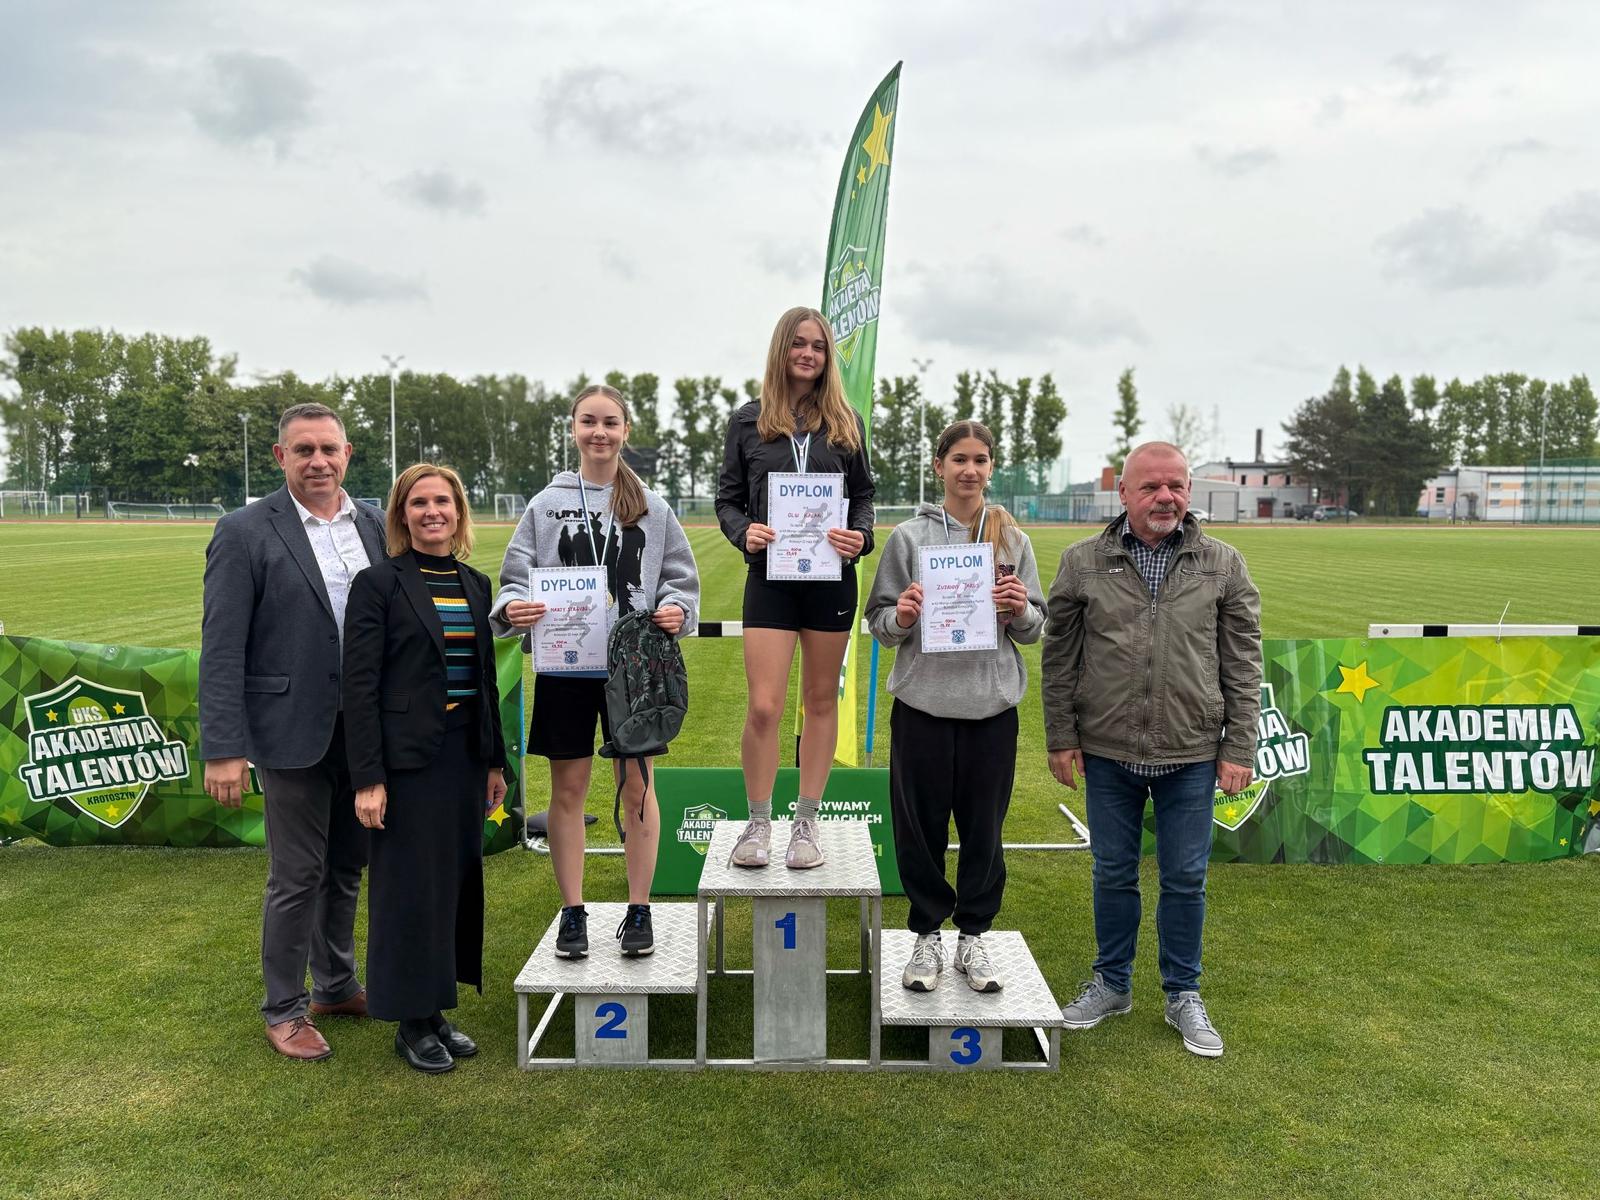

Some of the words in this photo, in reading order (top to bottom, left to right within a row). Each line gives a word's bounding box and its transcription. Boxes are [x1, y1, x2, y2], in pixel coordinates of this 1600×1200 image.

[780, 485, 833, 497] DYPLOM
[930, 555, 983, 570] DYPLOM
[541, 578, 597, 592] DYPLOM
[71, 705, 104, 724] UKS
[1384, 708, 1581, 742] AKADEMIA
[34, 720, 162, 761] AKADEMIA
[25, 745, 185, 797] TALENTÓW
[1366, 742, 1595, 791] TALENTÓW
[87, 791, 136, 806] KROTOSZYN
[788, 801, 871, 811] ORYWAMY
[1214, 789, 1256, 806] ROTOSZYN
[775, 912, 796, 950] 1
[595, 1002, 627, 1039] 2
[950, 1027, 982, 1066] 3
